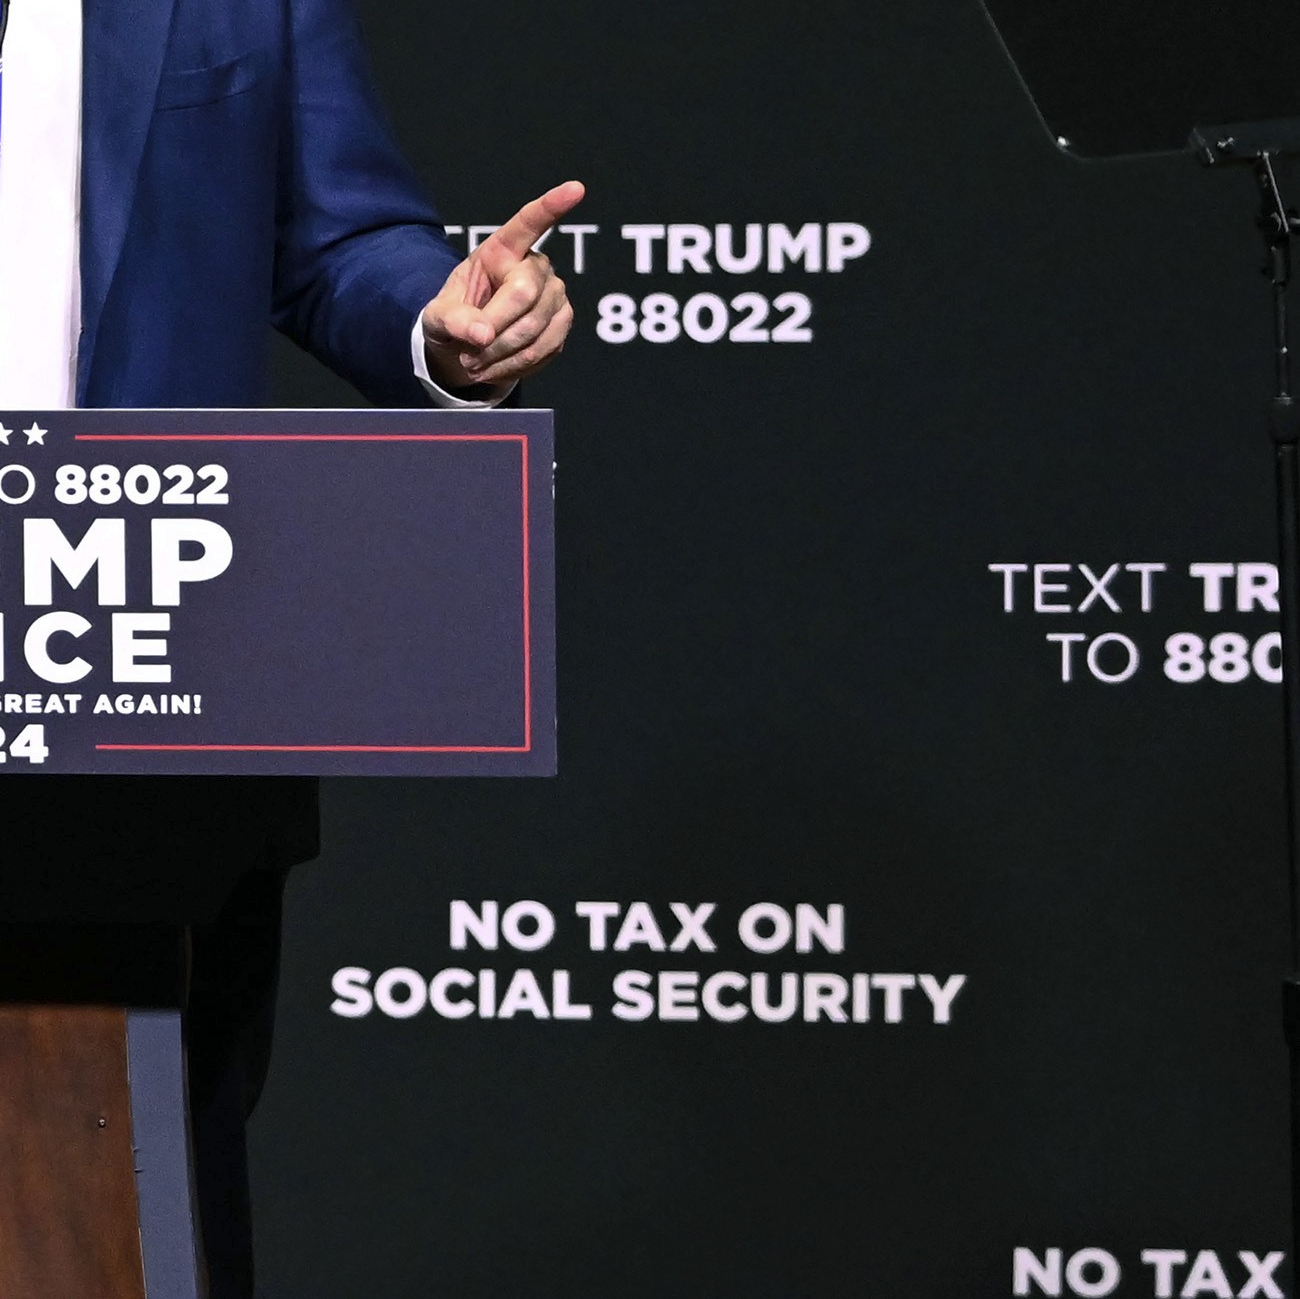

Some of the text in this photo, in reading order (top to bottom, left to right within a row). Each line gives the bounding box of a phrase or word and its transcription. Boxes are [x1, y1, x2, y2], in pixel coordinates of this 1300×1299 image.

[621, 222, 871, 274] TRUMP
[596, 291, 813, 344] 88022
[54, 463, 230, 506] 88022
[988, 562, 1166, 613] TEXT
[1045, 632, 1139, 683] TO
[92, 693, 202, 715] AGAIN!
[449, 900, 844, 954] NO TAX ON
[330, 966, 966, 1024] SOCIAL SECURITY
[1013, 1247, 1284, 1299] NO TAX
